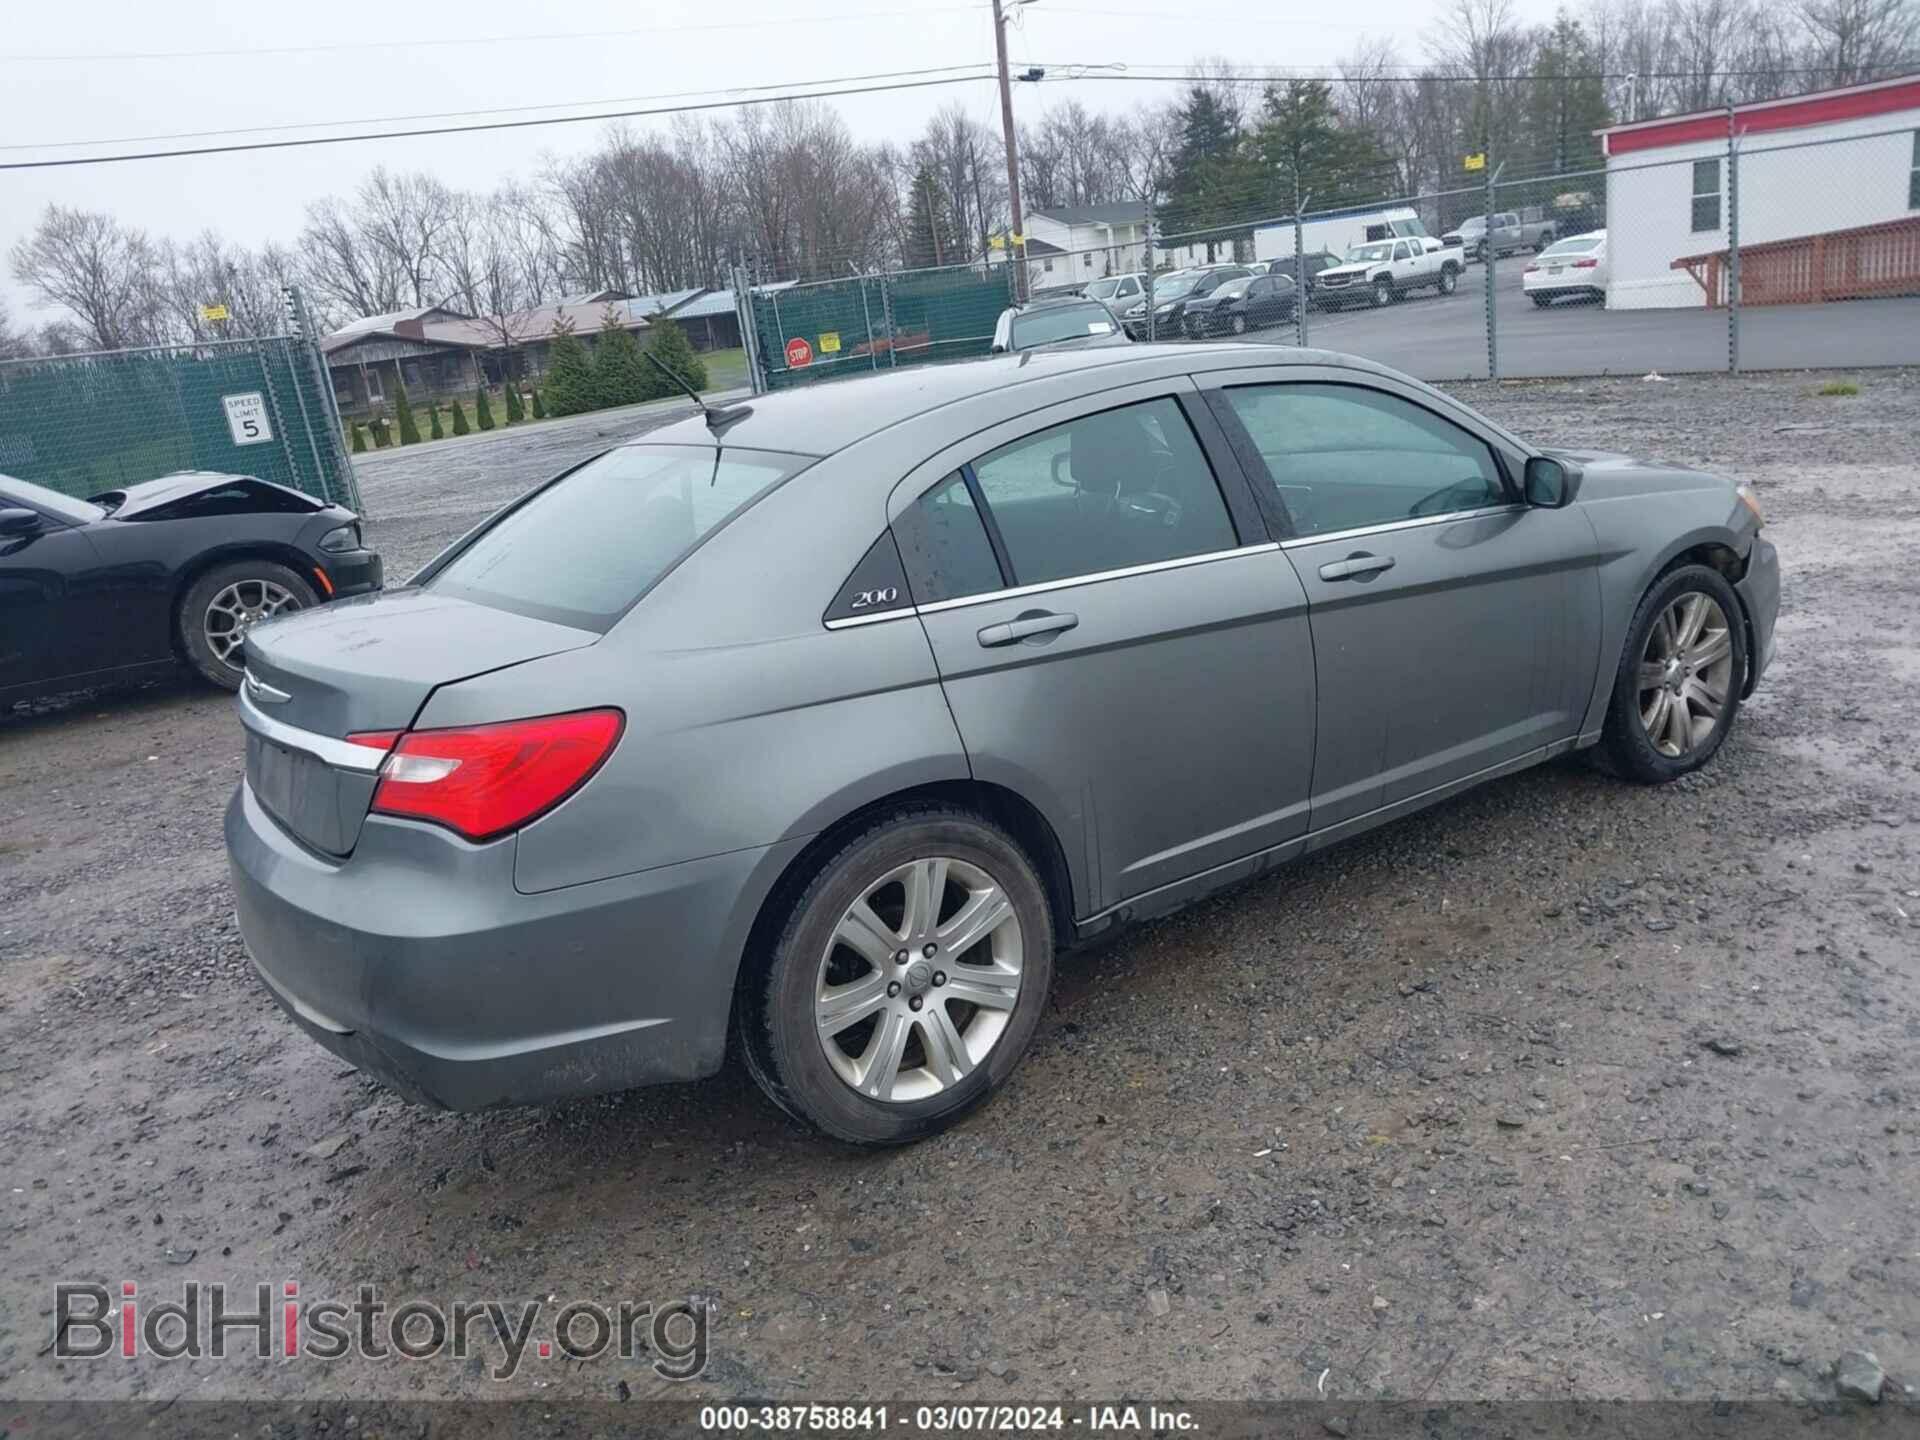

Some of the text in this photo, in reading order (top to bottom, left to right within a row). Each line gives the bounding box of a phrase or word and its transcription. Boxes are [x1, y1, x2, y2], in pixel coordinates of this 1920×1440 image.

[789, 346, 809, 362] STOP
[228, 397, 260, 408] SPEED
[234, 407, 260, 418] LIMIT
[243, 420, 260, 438] 5
[852, 586, 897, 608] 200
